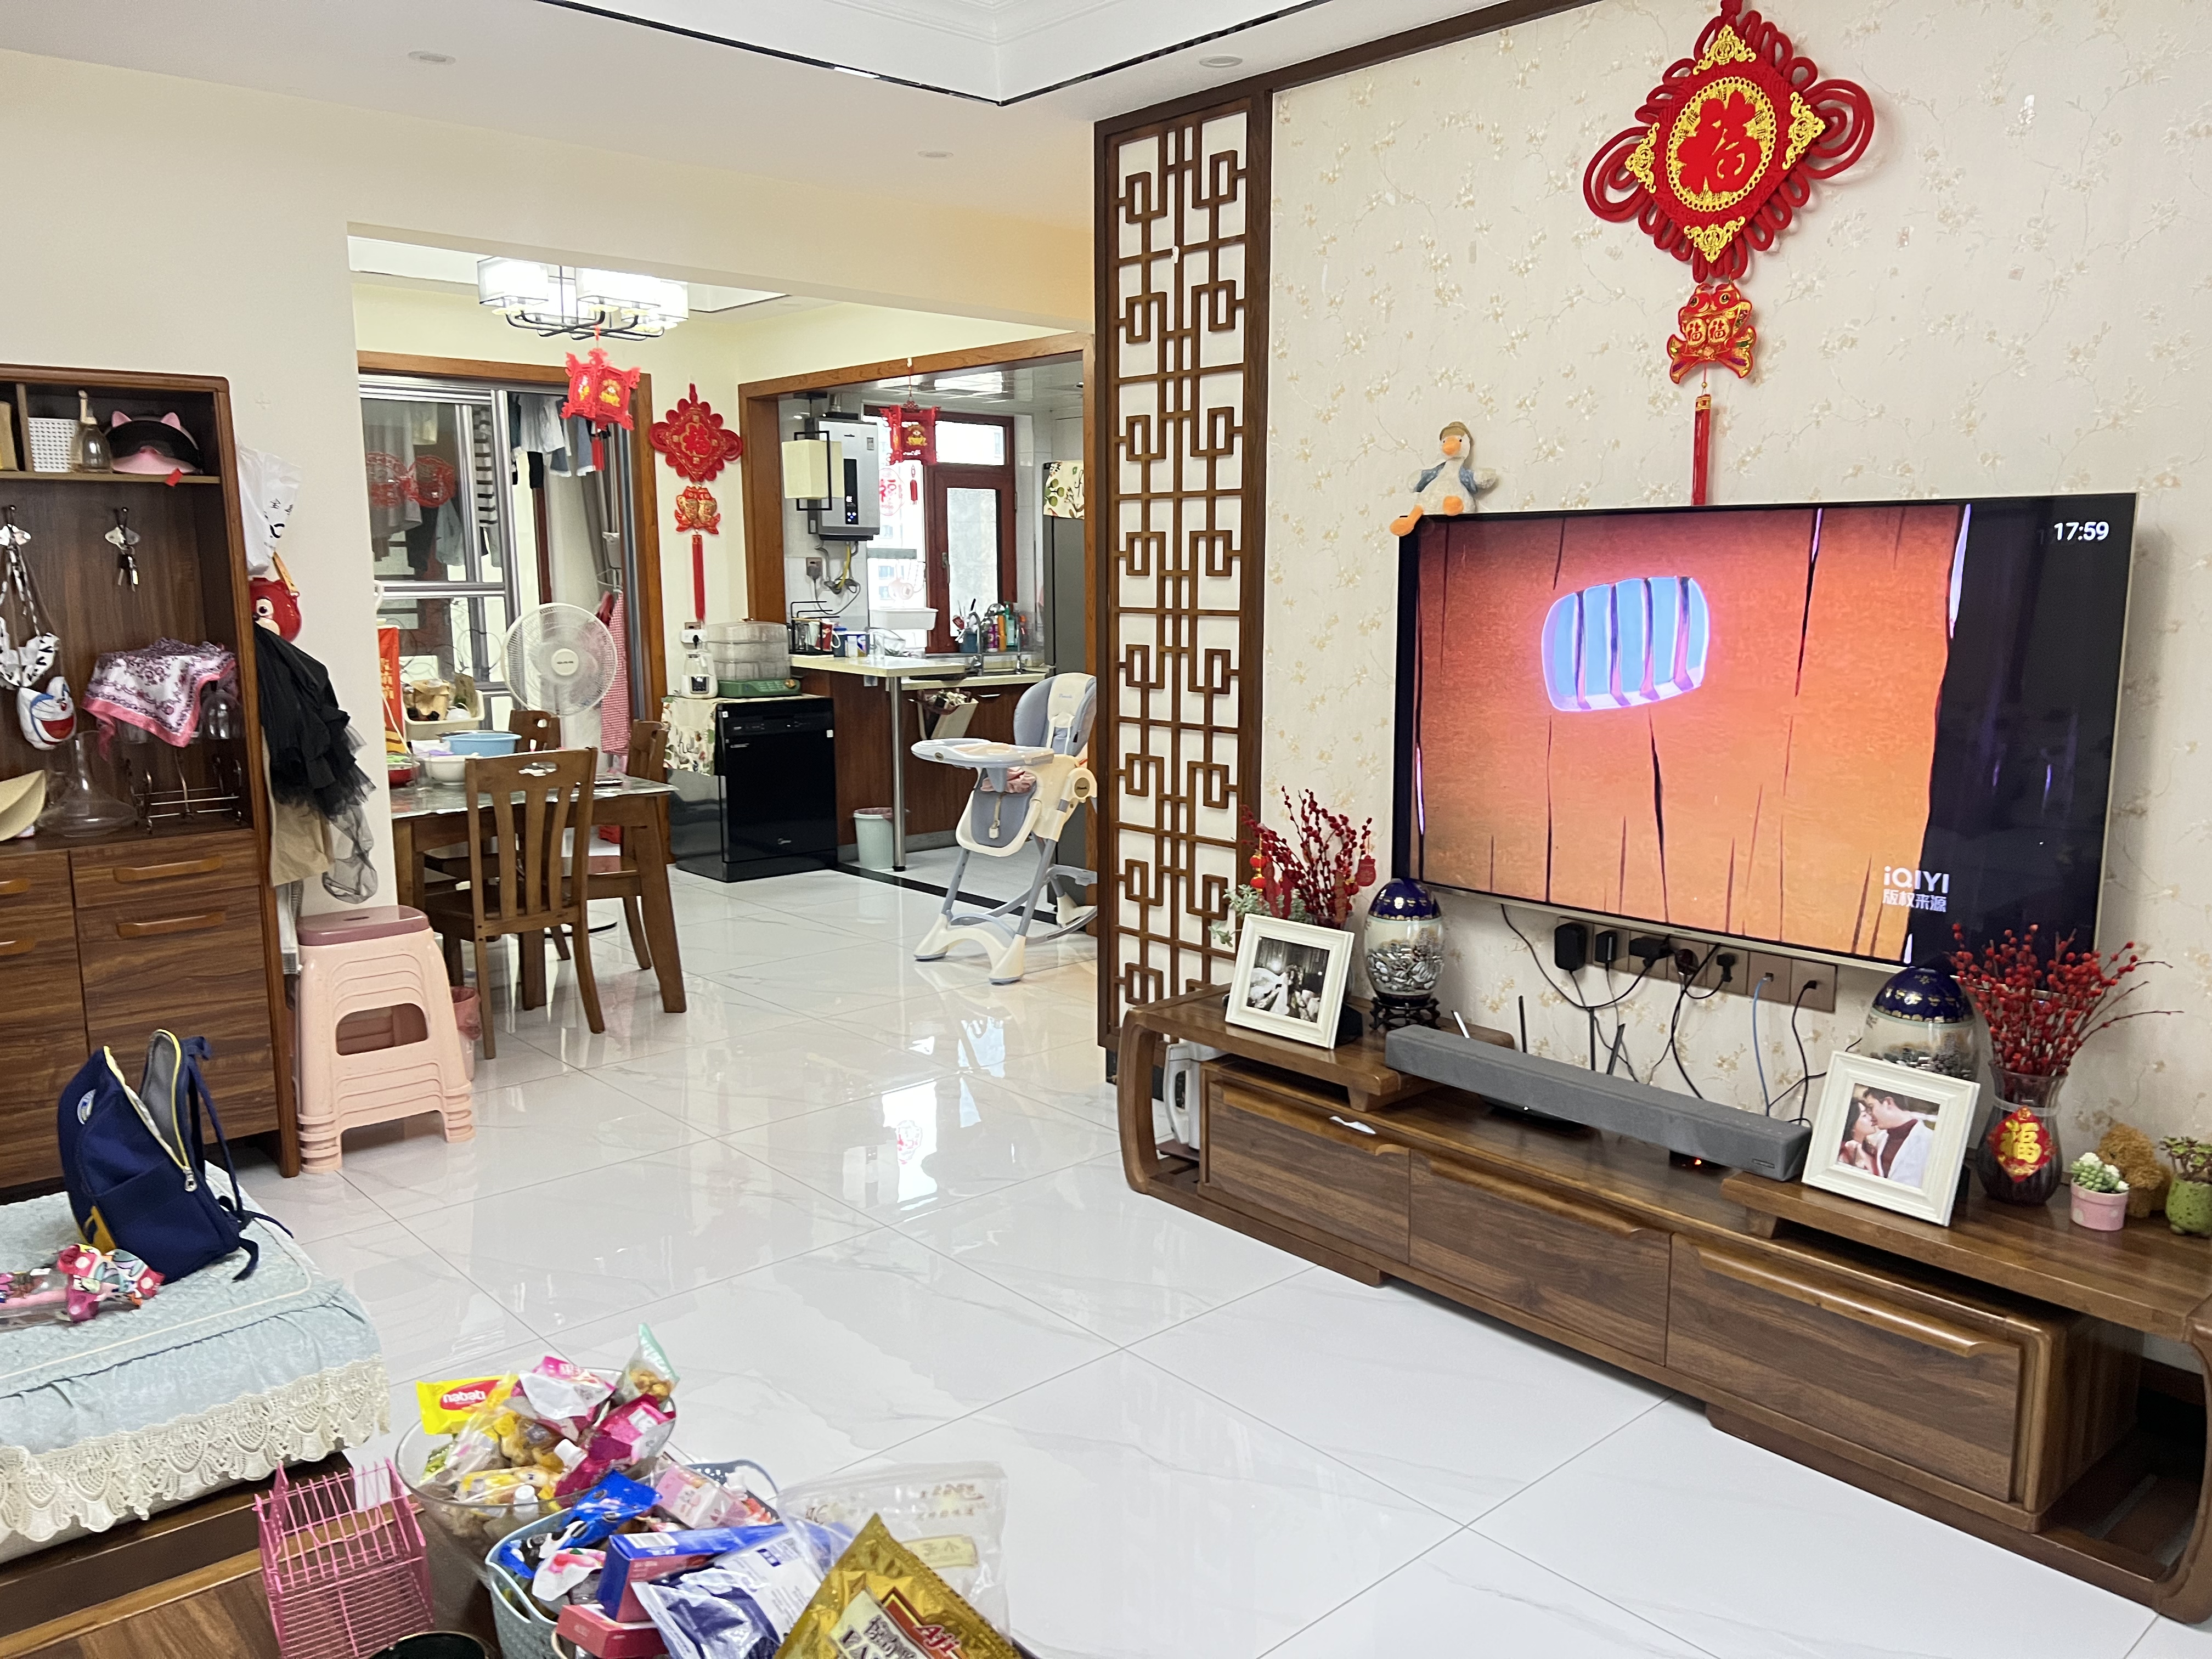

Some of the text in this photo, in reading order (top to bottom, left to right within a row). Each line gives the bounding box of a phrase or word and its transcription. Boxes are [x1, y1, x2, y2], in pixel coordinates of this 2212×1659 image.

[1677, 89, 1762, 194] 福
[2054, 521, 2109, 541] 17:59
[1883, 866, 1950, 893] iQIYI
[1882, 888, 1947, 912] 版权来源
[2000, 1119, 2042, 1164] 福
[913, 1624, 961, 1656] Aji
